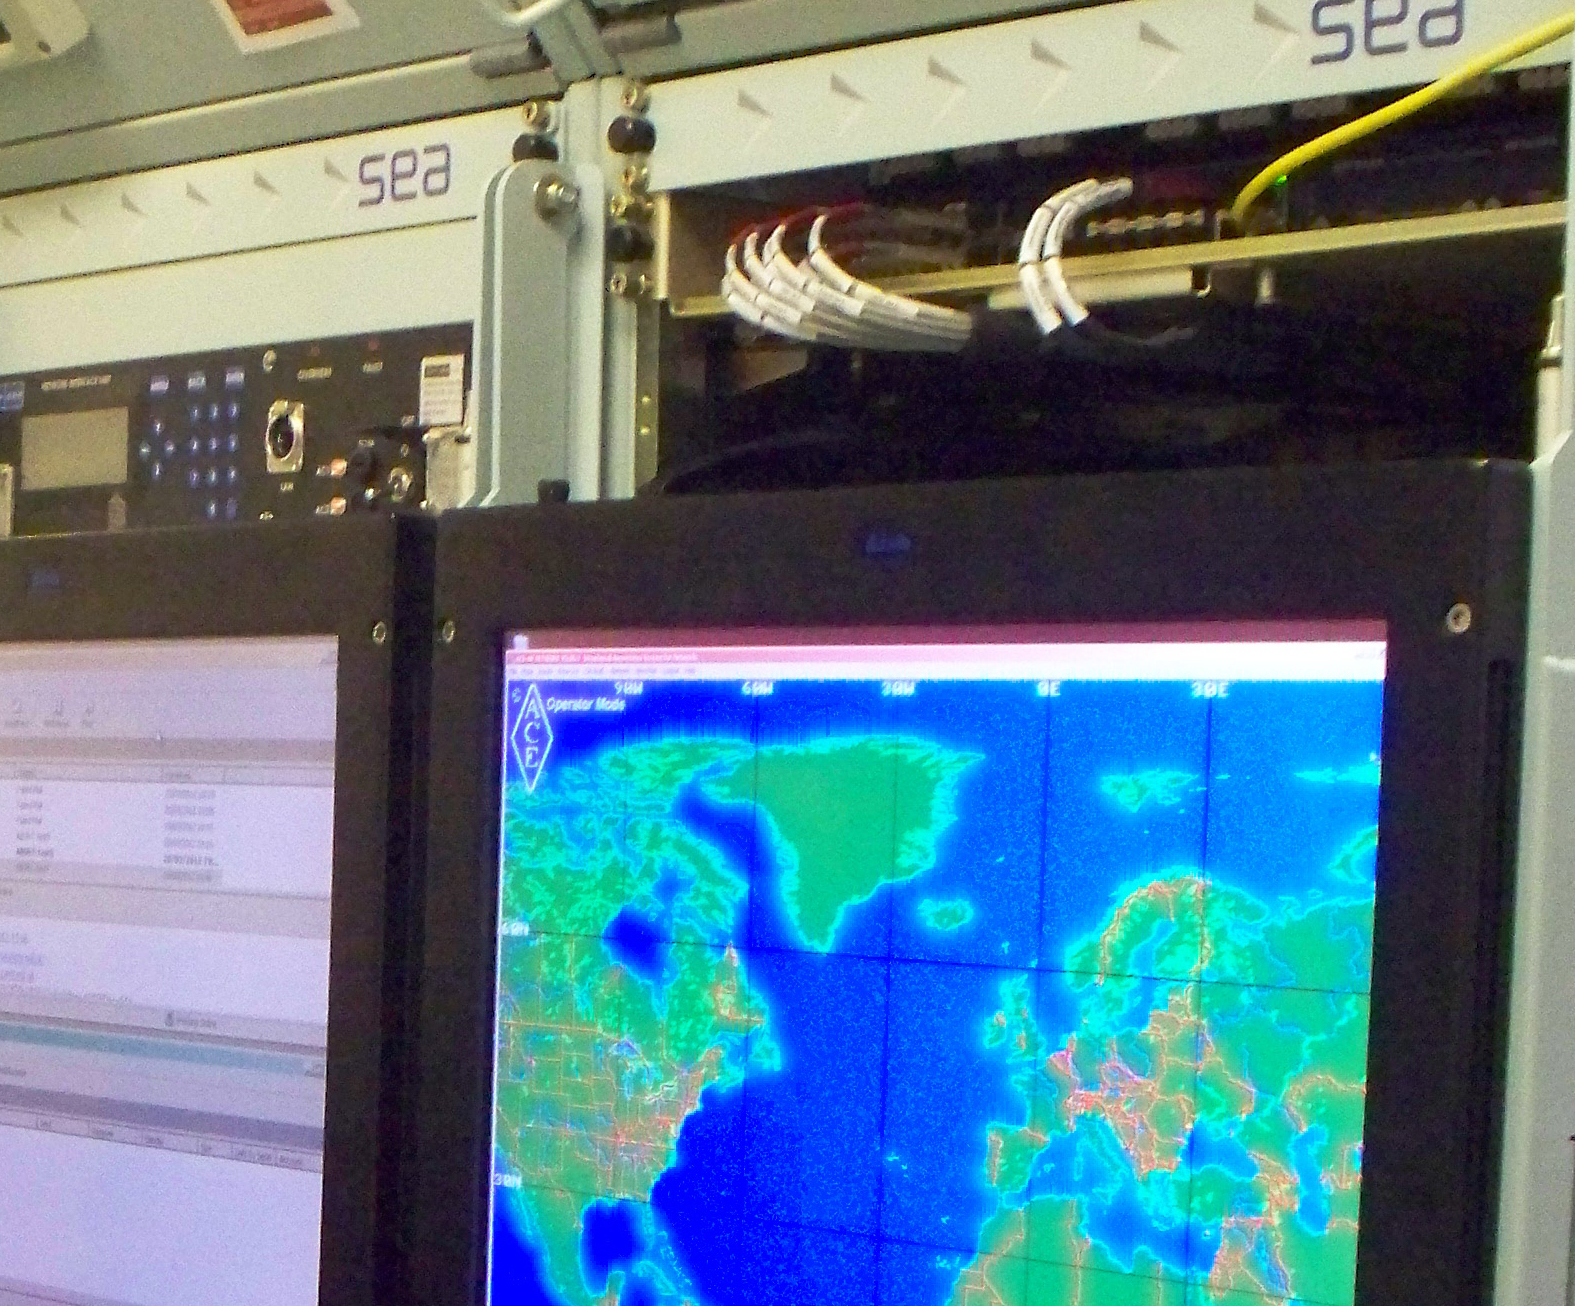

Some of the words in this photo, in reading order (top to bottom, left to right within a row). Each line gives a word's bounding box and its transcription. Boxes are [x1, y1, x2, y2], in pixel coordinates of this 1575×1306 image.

[1311, 0, 1464, 65] sea
[358, 143, 450, 207] sea
[546, 698, 593, 713] Operator
